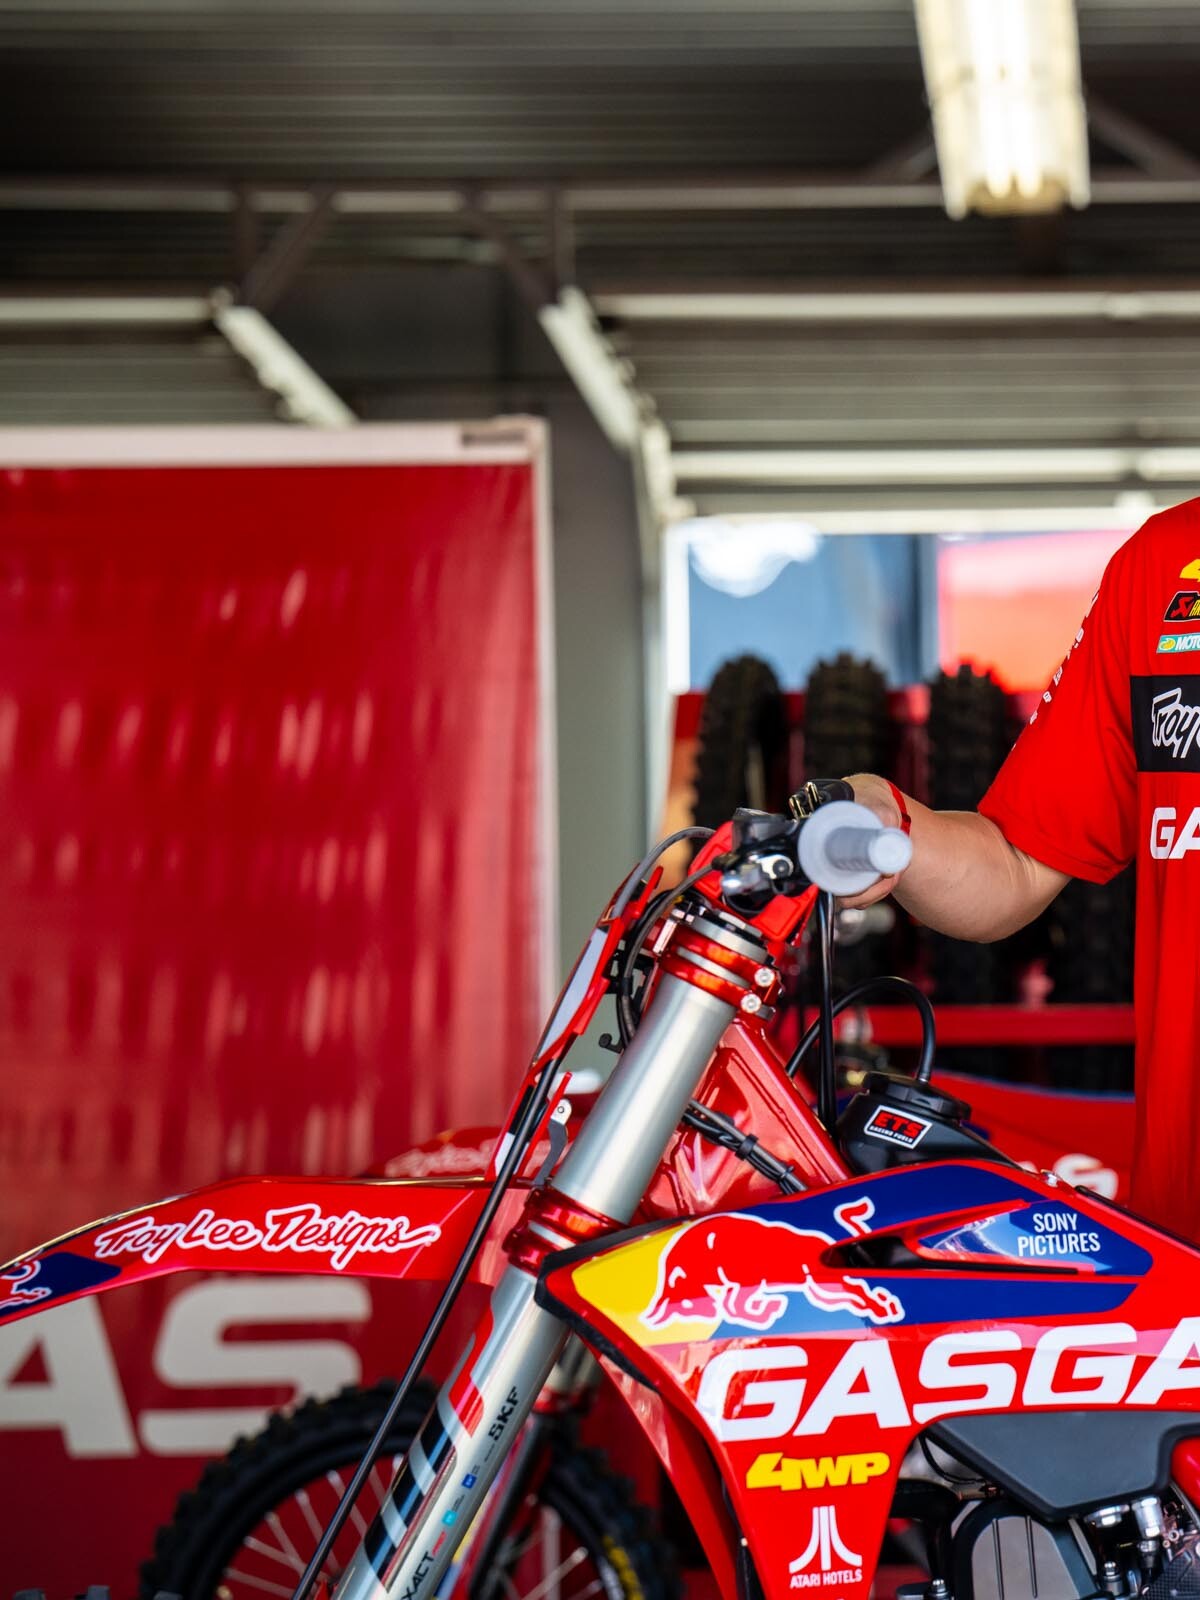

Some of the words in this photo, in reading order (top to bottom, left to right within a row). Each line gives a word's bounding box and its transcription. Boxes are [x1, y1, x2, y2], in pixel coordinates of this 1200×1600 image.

[1152, 687, 1200, 758] Troy
[874, 1111, 924, 1138] ETS
[1033, 1213, 1077, 1233] SONY
[95, 1216, 184, 1264] Troy
[177, 1209, 263, 1251] Lee
[261, 1203, 441, 1271] Designs
[1017, 1233, 1100, 1257] PICTURES
[488, 1386, 519, 1441] SKF
[790, 1573, 820, 1589] ATARI
[822, 1569, 862, 1585] HOTELS
